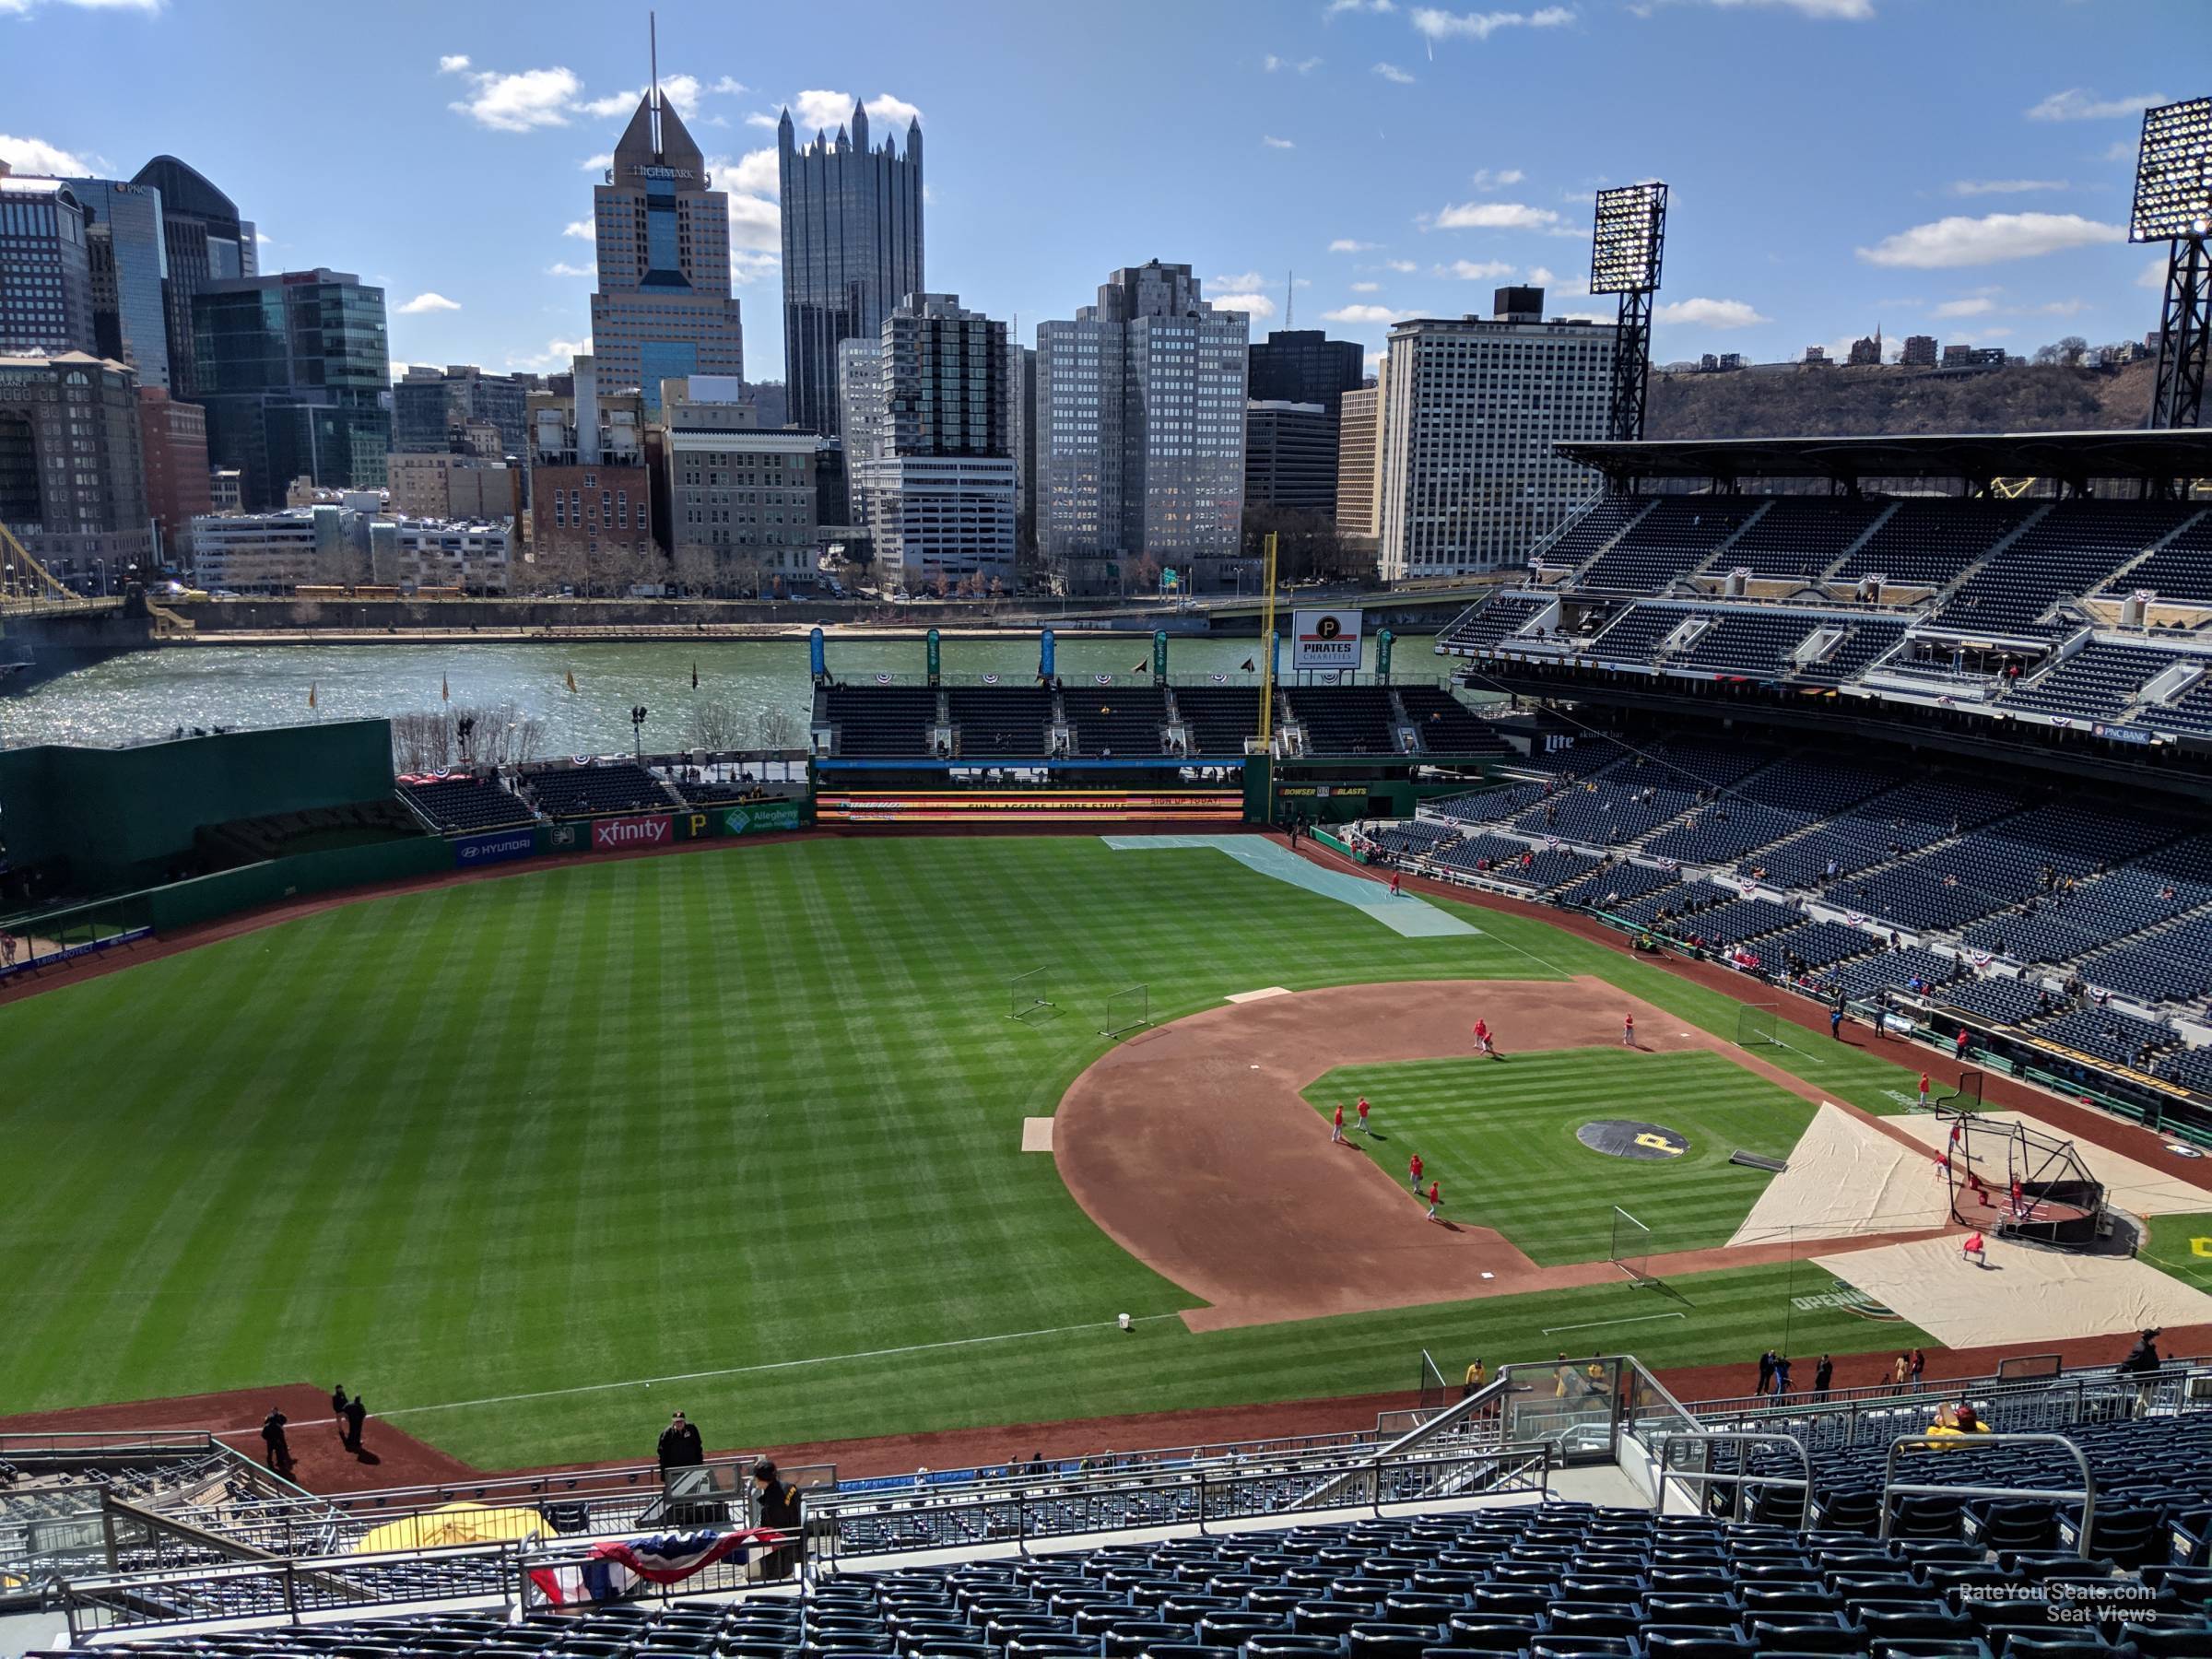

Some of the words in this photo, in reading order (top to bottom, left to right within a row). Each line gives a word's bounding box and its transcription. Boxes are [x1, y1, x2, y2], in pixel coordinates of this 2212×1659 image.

[633, 165, 694, 179] HIGHMARK
[127, 183, 146, 194] PNC
[1324, 621, 1335, 636] P
[1303, 643, 1352, 653] PIRATES
[2104, 727, 2123, 737] PNC
[2123, 730, 2147, 742] BANK
[1545, 735, 1575, 753] Lite
[1337, 787, 1367, 795] BLASTS
[754, 809, 798, 820] Allegheny
[598, 819, 666, 846] xfinity
[690, 814, 707, 836] P
[481, 839, 531, 855] HYUNDAI
